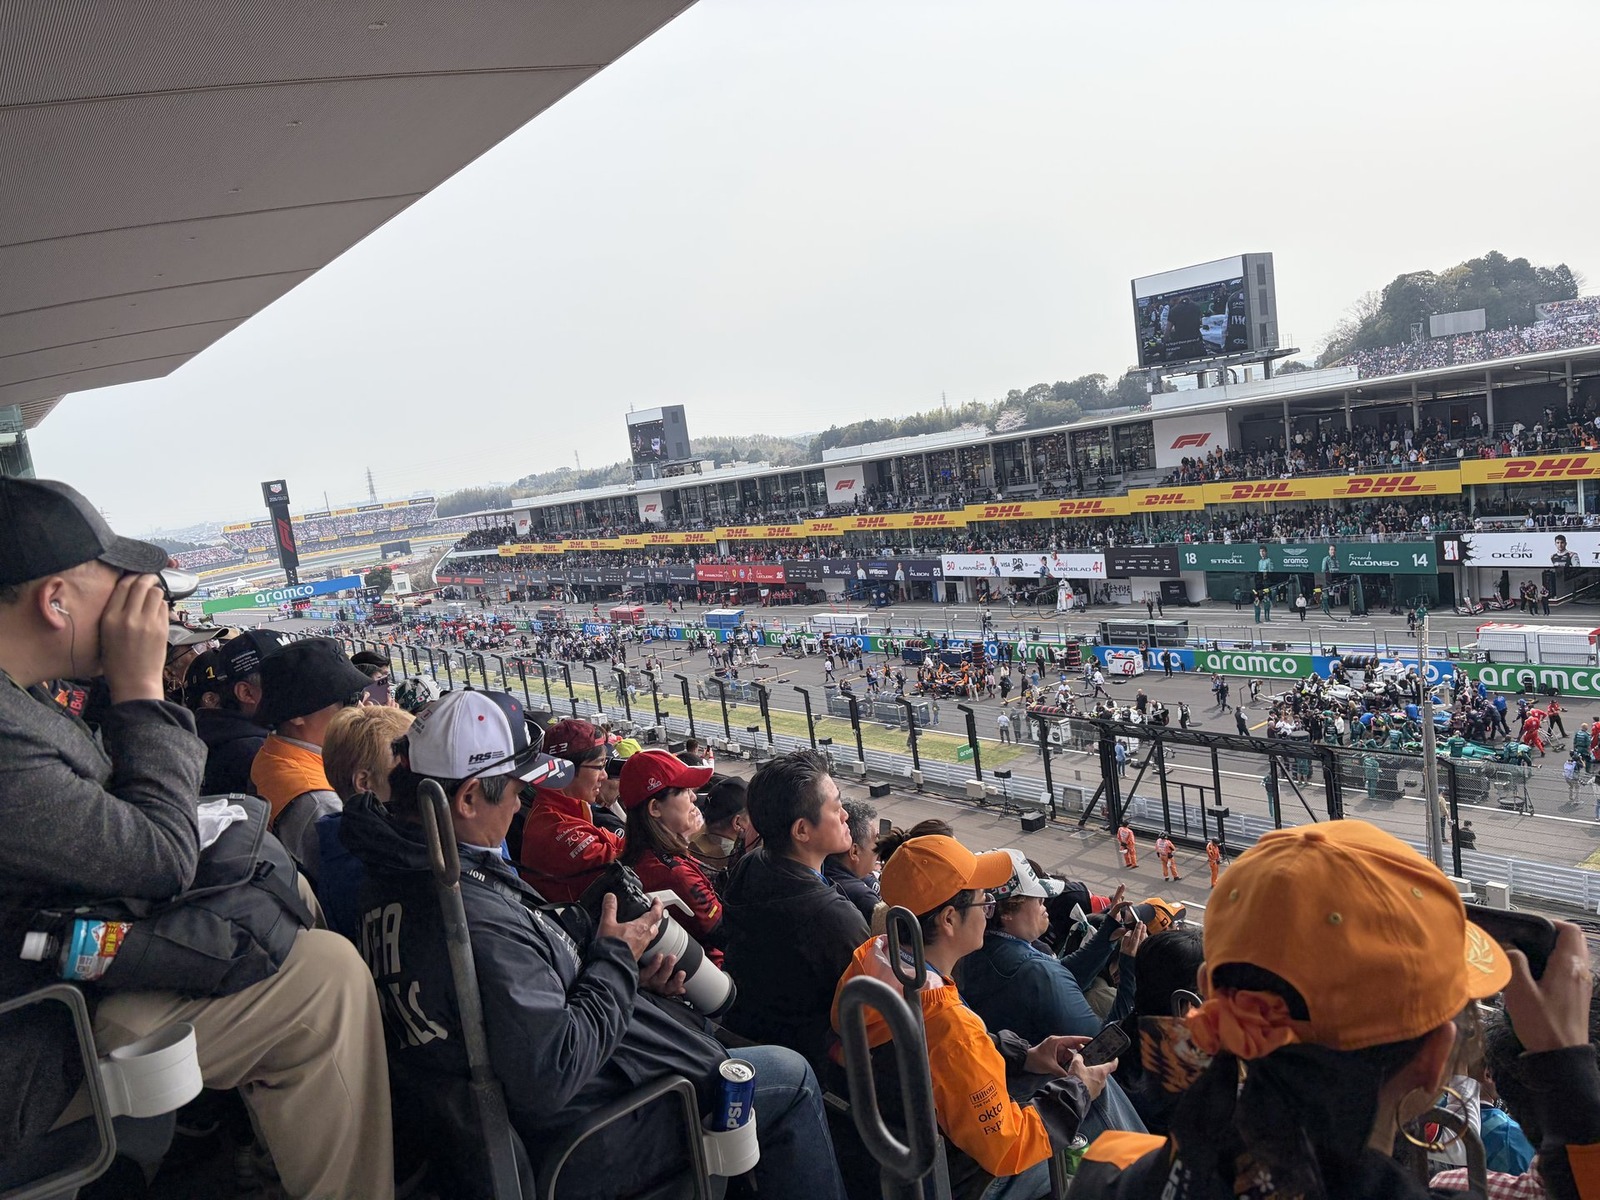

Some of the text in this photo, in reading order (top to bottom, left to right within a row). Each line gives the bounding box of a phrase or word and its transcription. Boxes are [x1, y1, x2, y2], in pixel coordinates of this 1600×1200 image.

[1170, 432, 1211, 450] F1
[1503, 457, 1595, 478] DHL
[834, 479, 855, 490] F1
[1231, 482, 1292, 499] DHL
[1345, 475, 1419, 494] DHL
[1145, 493, 1186, 506] DHL
[984, 504, 1025, 517] DHL
[1058, 500, 1105, 515] DHL
[856, 516, 888, 528] DHL
[912, 514, 949, 526] DHL
[726, 528, 749, 537] DHL
[767, 527, 793, 536] DHL
[812, 523, 834, 532] DHL
[651, 534, 671, 543] DHL
[685, 533, 706, 542] DHL
[1185, 552, 1197, 565] 18
[1412, 553, 1429, 567] 14
[255, 585, 314, 603] aramco
[1206, 654, 1298, 674] aramco
[205, 666, 215, 679] 1
[468, 751, 492, 762] HRS
[971, 1084, 995, 1102] Hilton
[727, 1101, 743, 1129] PSI
[978, 1101, 1004, 1123] okta
